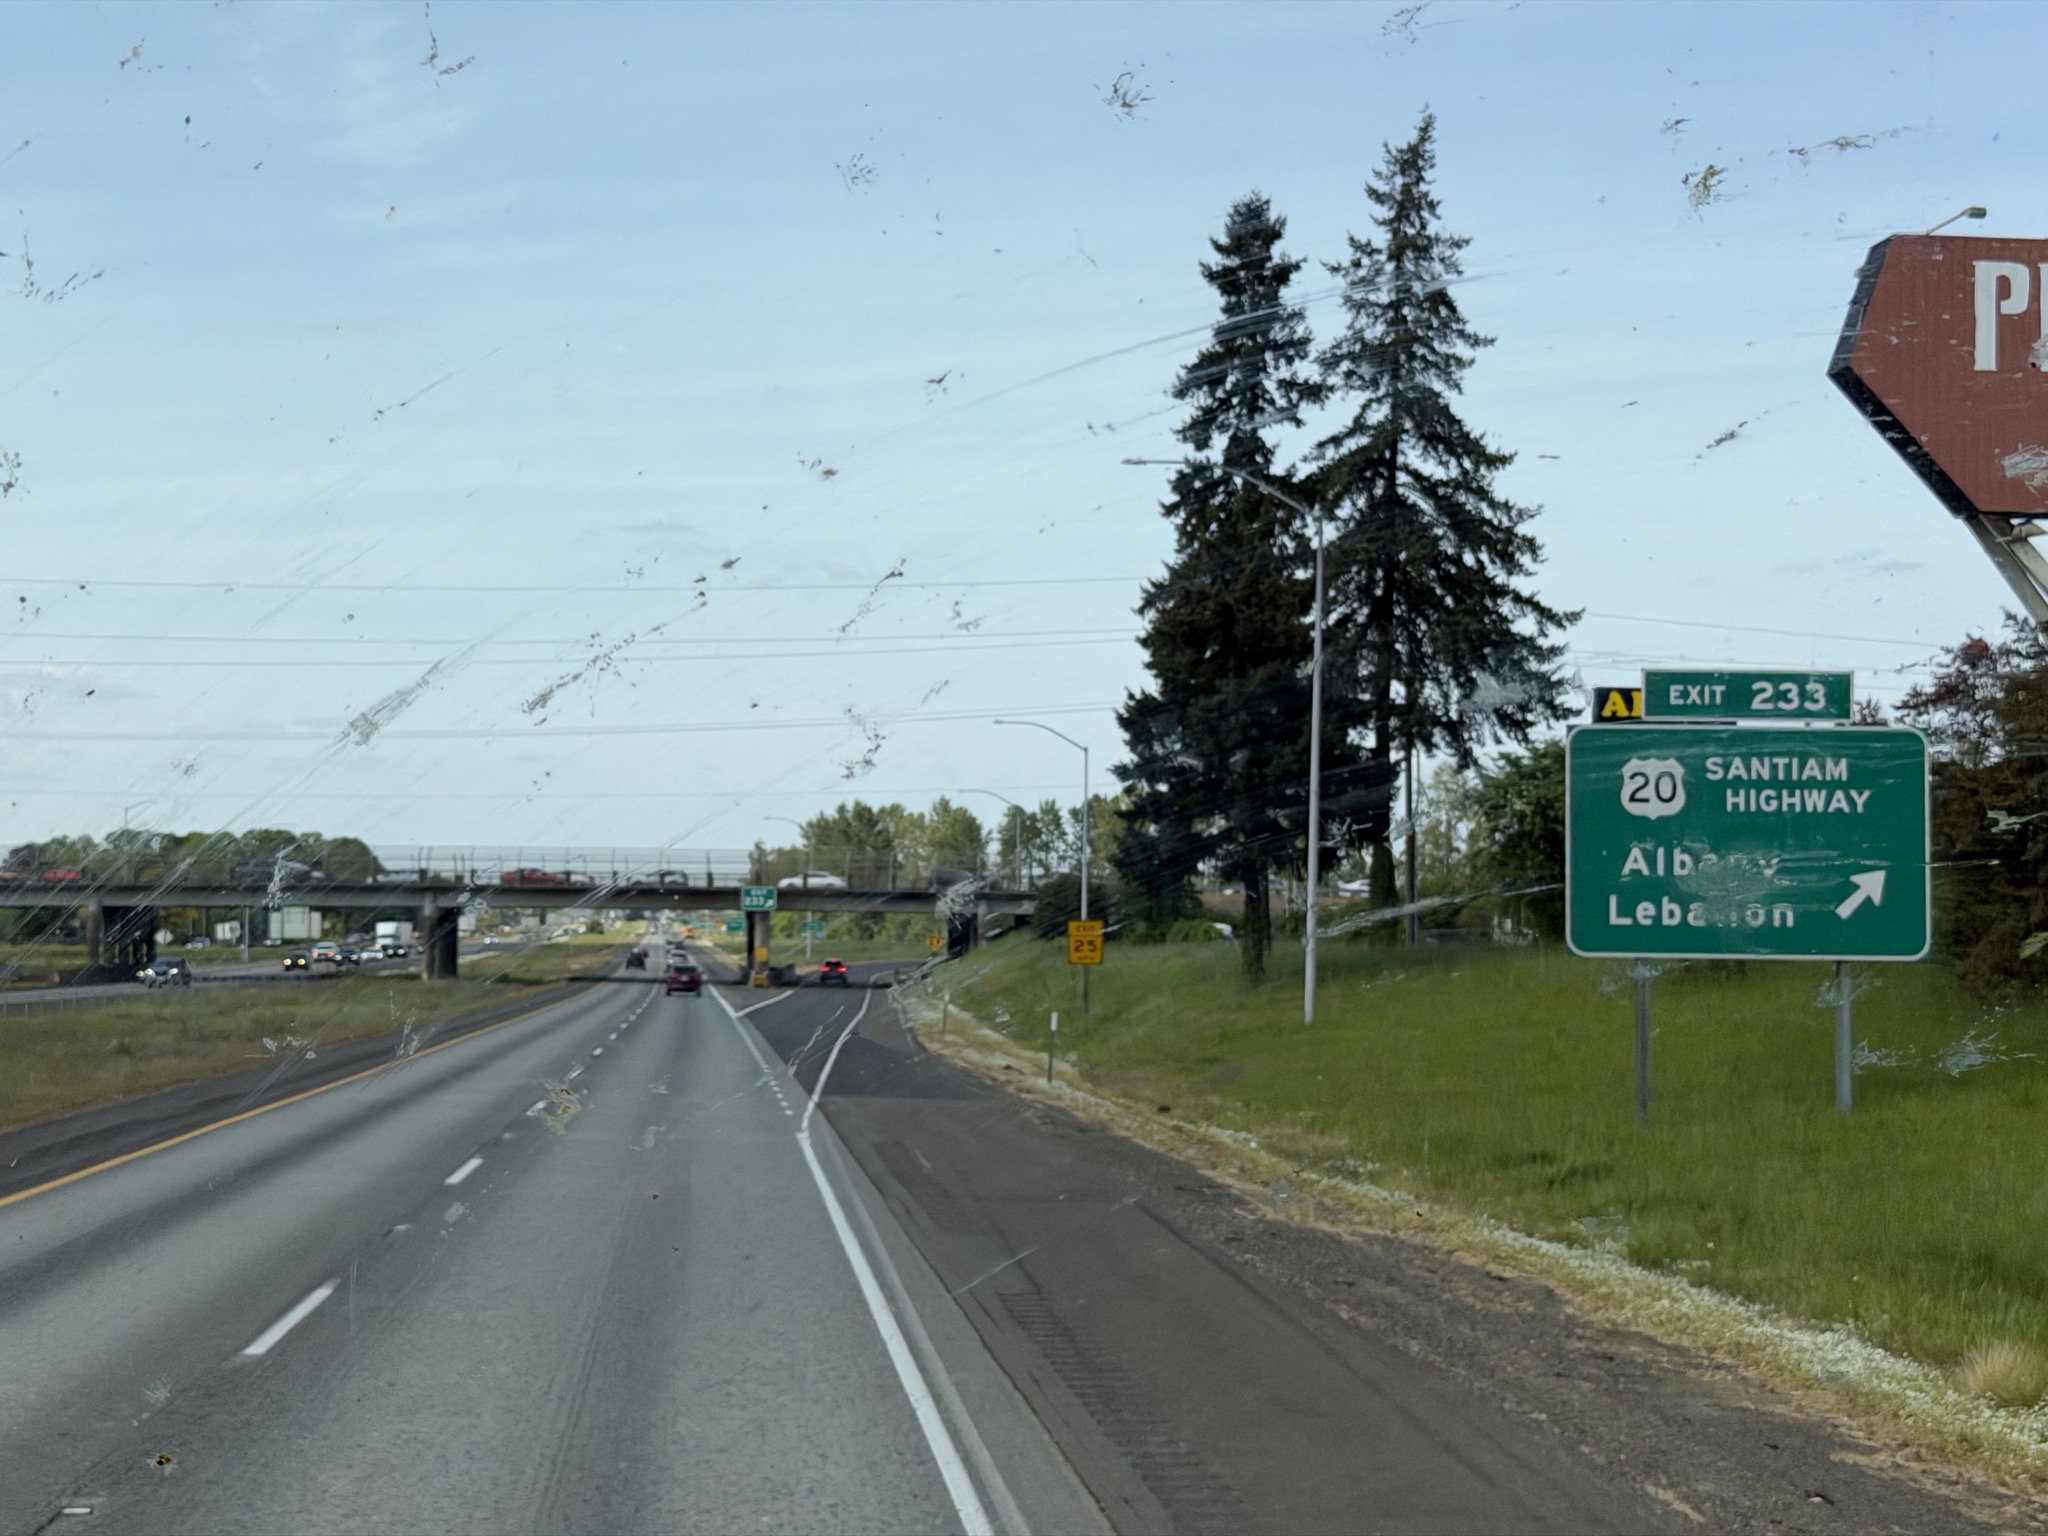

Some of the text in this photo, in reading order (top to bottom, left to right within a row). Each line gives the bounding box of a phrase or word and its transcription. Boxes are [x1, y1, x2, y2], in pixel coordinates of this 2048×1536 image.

[1669, 681, 1827, 711] EXIT 233
[1705, 757, 1848, 781] SANTIAM
[1628, 771, 1677, 803] 20
[1727, 789, 1871, 813] HIGHWAY
[1621, 846, 1781, 881] Alby
[1609, 894, 1794, 928] Lebaon
[1074, 940, 1097, 952] 25
